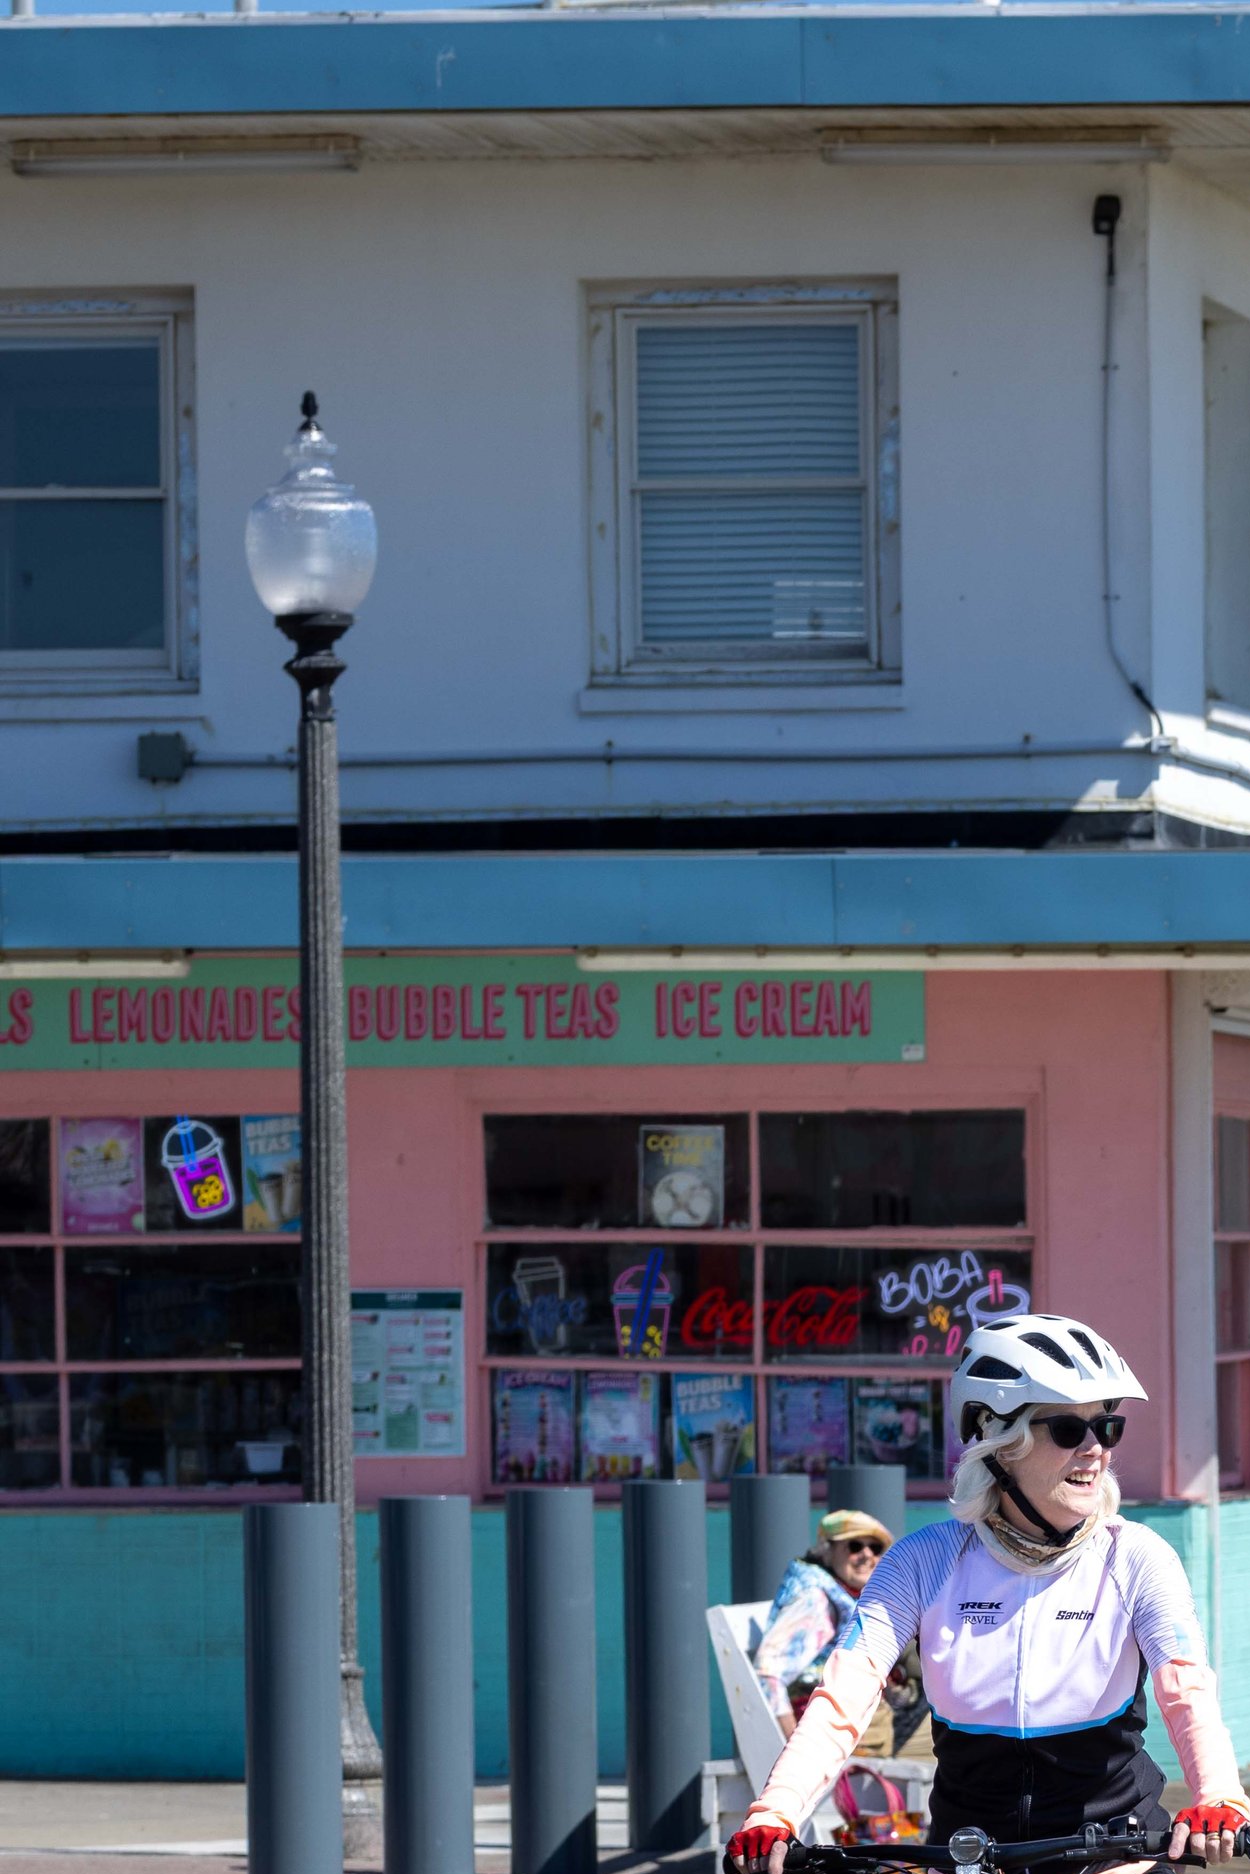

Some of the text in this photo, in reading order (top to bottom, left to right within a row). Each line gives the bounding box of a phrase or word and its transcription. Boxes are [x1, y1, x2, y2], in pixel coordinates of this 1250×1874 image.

[0, 987, 33, 1045] S
[348, 980, 872, 1041] BUBBLE TEAS ICE CREAM
[879, 1250, 984, 1313] BOBA
[677, 1376, 744, 1398] BUBBLE
[679, 1395, 723, 1414] TEAS
[958, 1601, 1004, 1610] TREK
